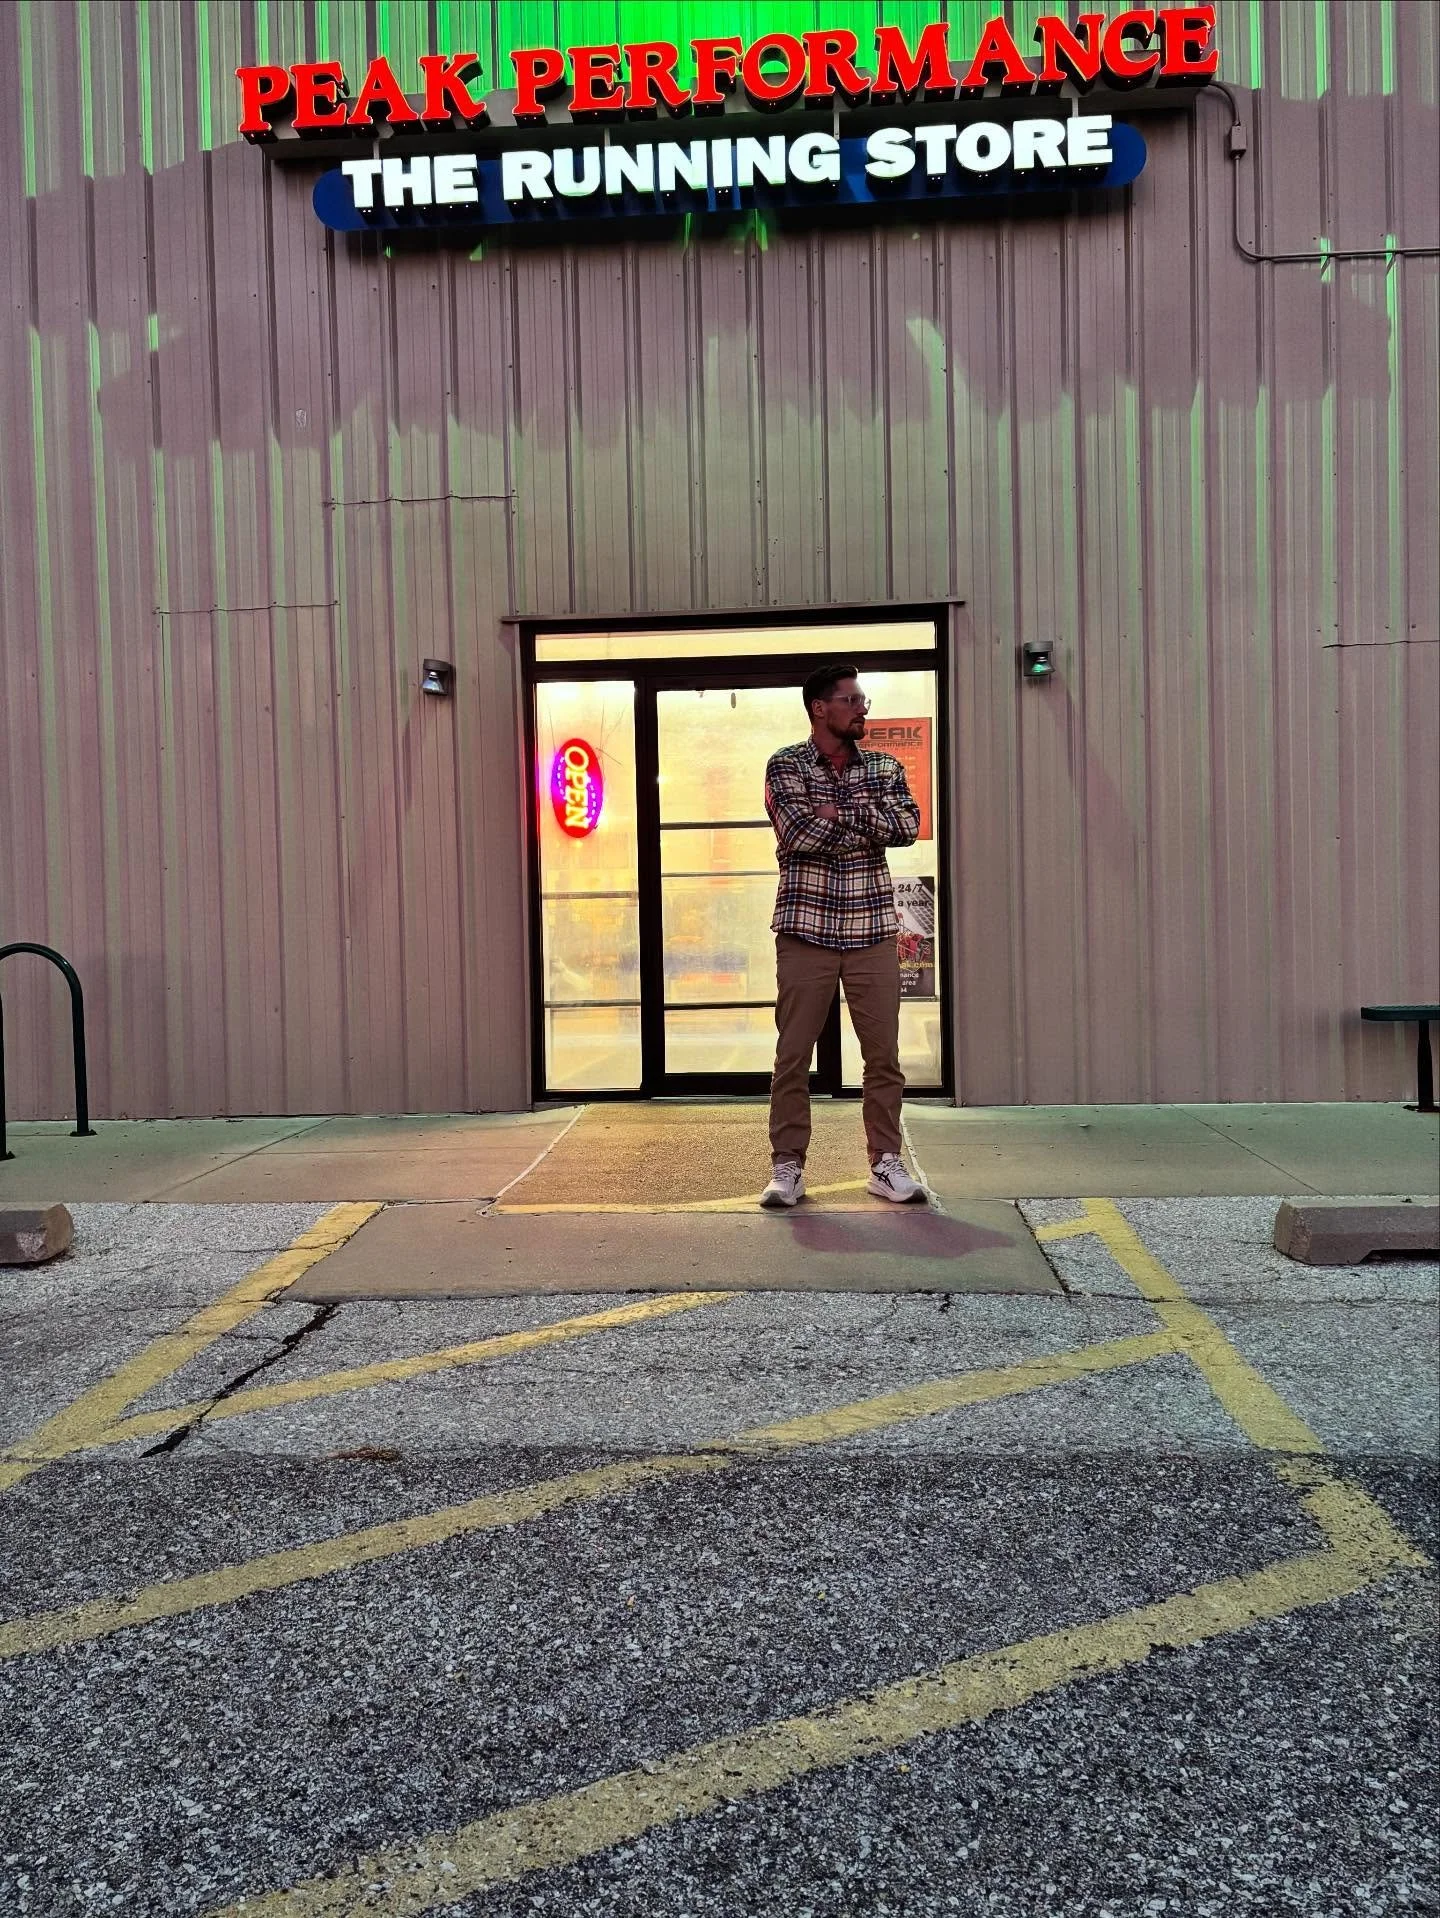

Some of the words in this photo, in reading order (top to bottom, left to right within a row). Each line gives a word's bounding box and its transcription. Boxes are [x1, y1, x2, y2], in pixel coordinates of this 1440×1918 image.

[235, 53, 487, 132] PEAK
[510, 6, 1220, 116] PERFORMANCE
[341, 153, 479, 208] THE
[501, 132, 841, 205] RUNNING
[865, 114, 1113, 179] STORE
[564, 746, 591, 830] OPEN
[898, 883, 923, 894] 24/7
